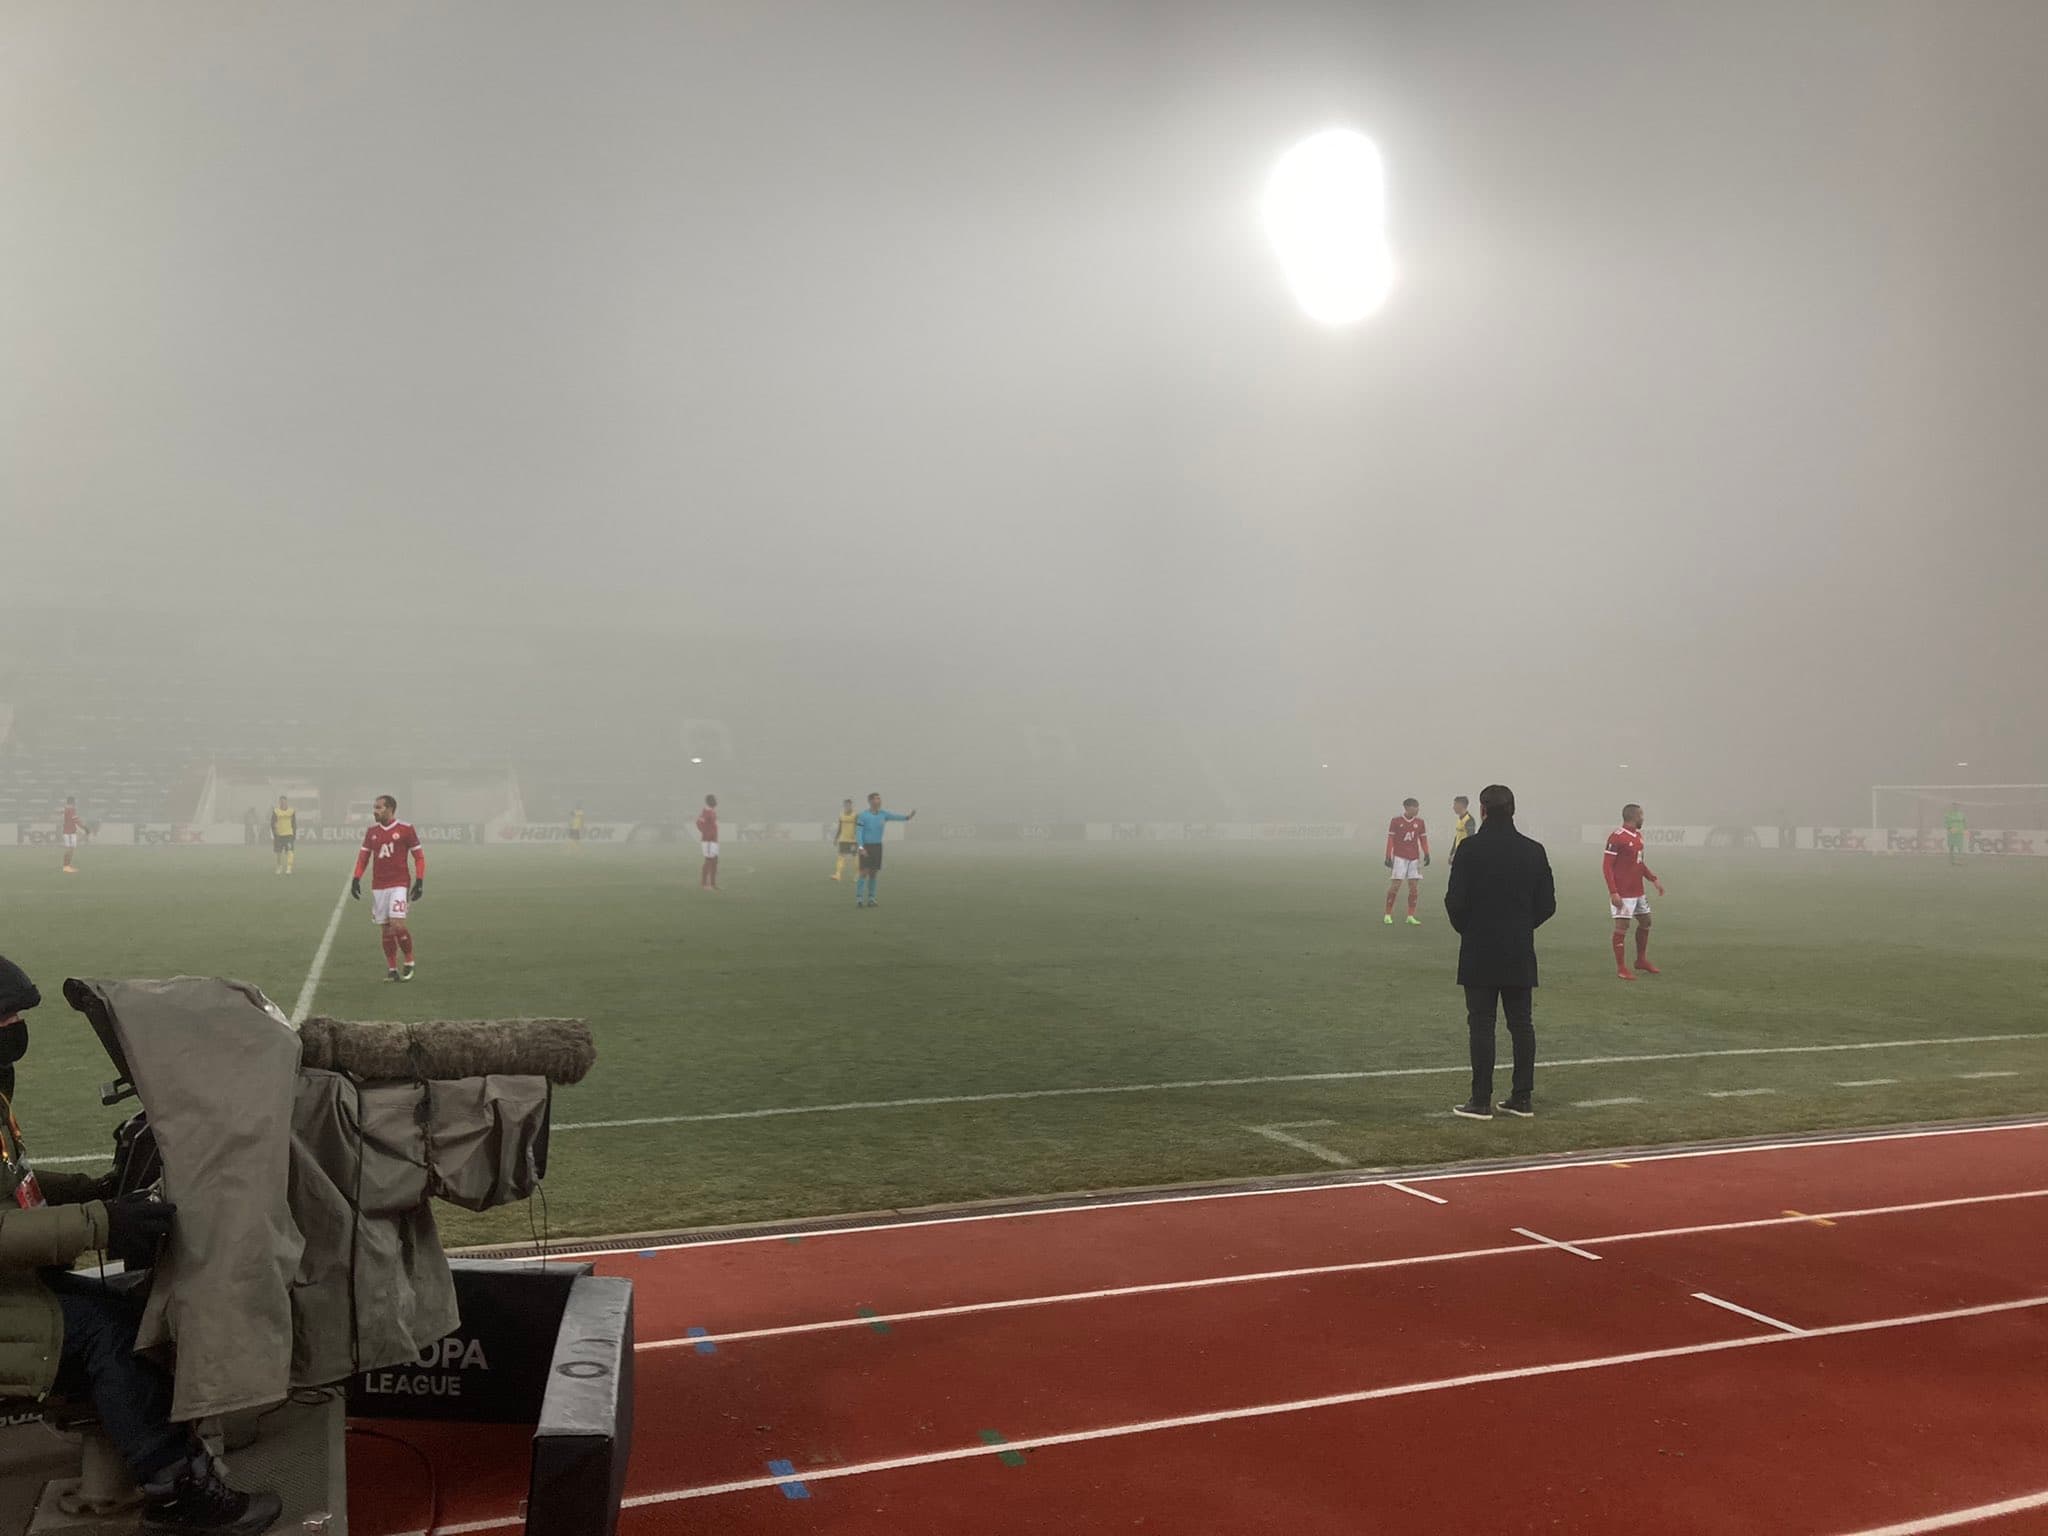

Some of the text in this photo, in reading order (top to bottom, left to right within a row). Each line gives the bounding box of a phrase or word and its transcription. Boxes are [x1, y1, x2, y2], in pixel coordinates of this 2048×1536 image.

[17, 823, 90, 843] Fed
[1403, 831, 1415, 841] A1
[379, 842, 395, 858] A1
[402, 1337, 489, 1370] OPA
[365, 1372, 462, 1396] LEAGUE
